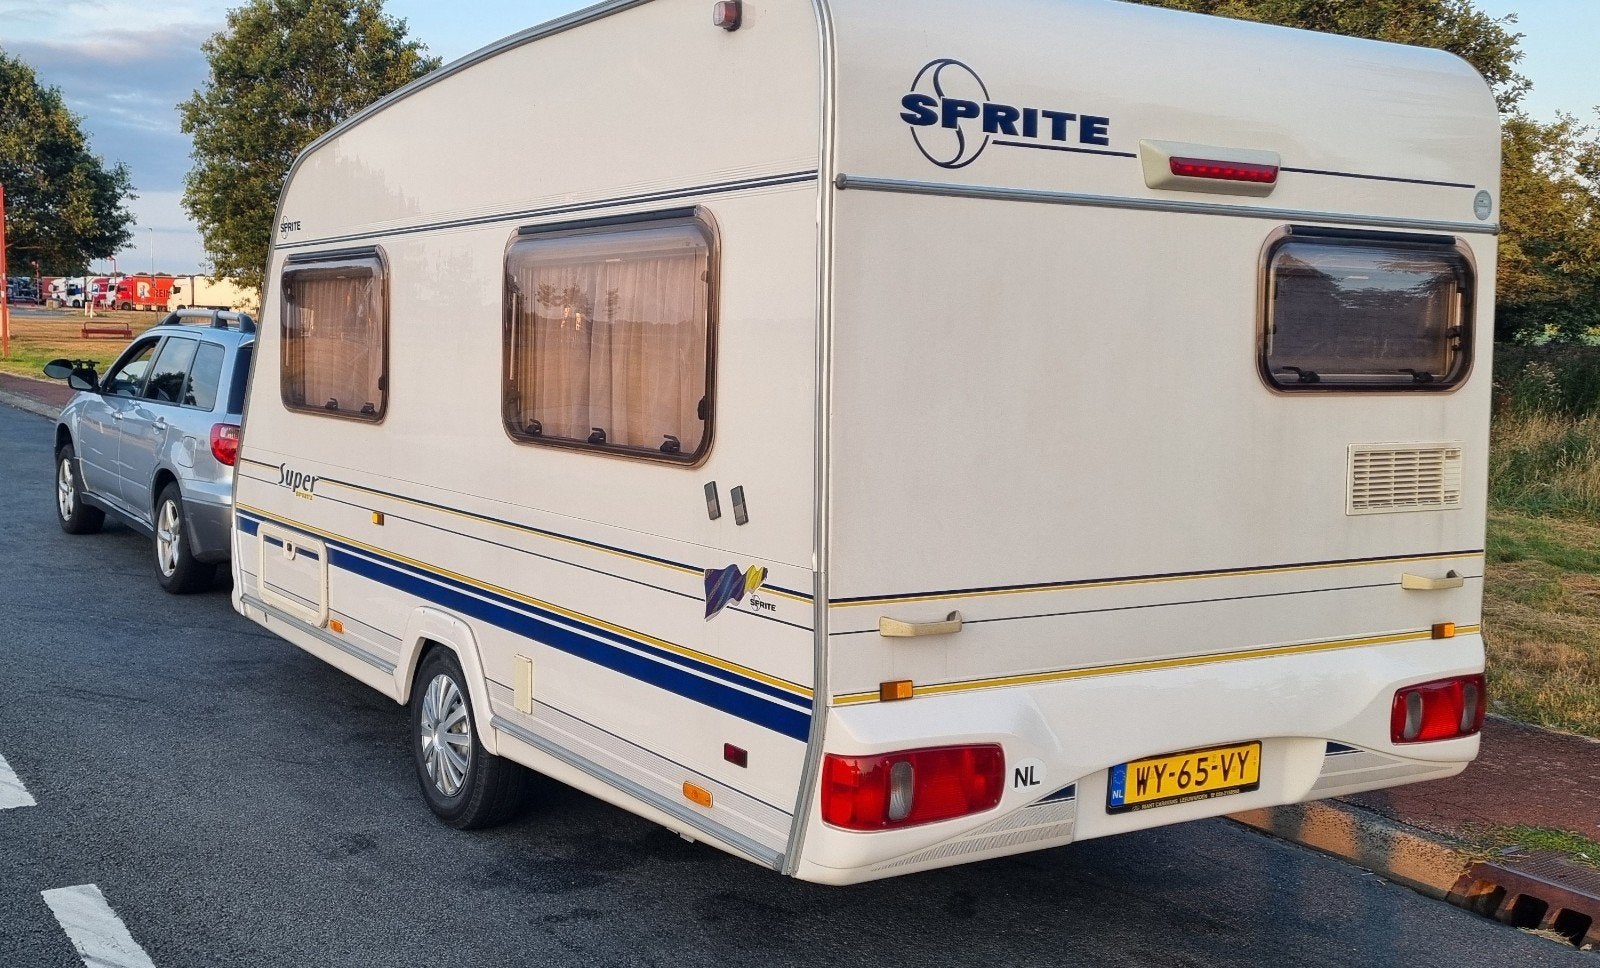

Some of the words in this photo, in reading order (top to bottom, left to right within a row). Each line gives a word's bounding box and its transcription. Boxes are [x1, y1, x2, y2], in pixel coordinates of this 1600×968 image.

[900, 93, 1110, 146] SPRITE
[280, 220, 301, 232] SPRITE
[278, 462, 319, 493] Super
[750, 598, 777, 611] SPRITE
[1014, 765, 1041, 788] NL
[1136, 750, 1250, 796] WY-65-VY
[1112, 790, 1124, 799] NL
